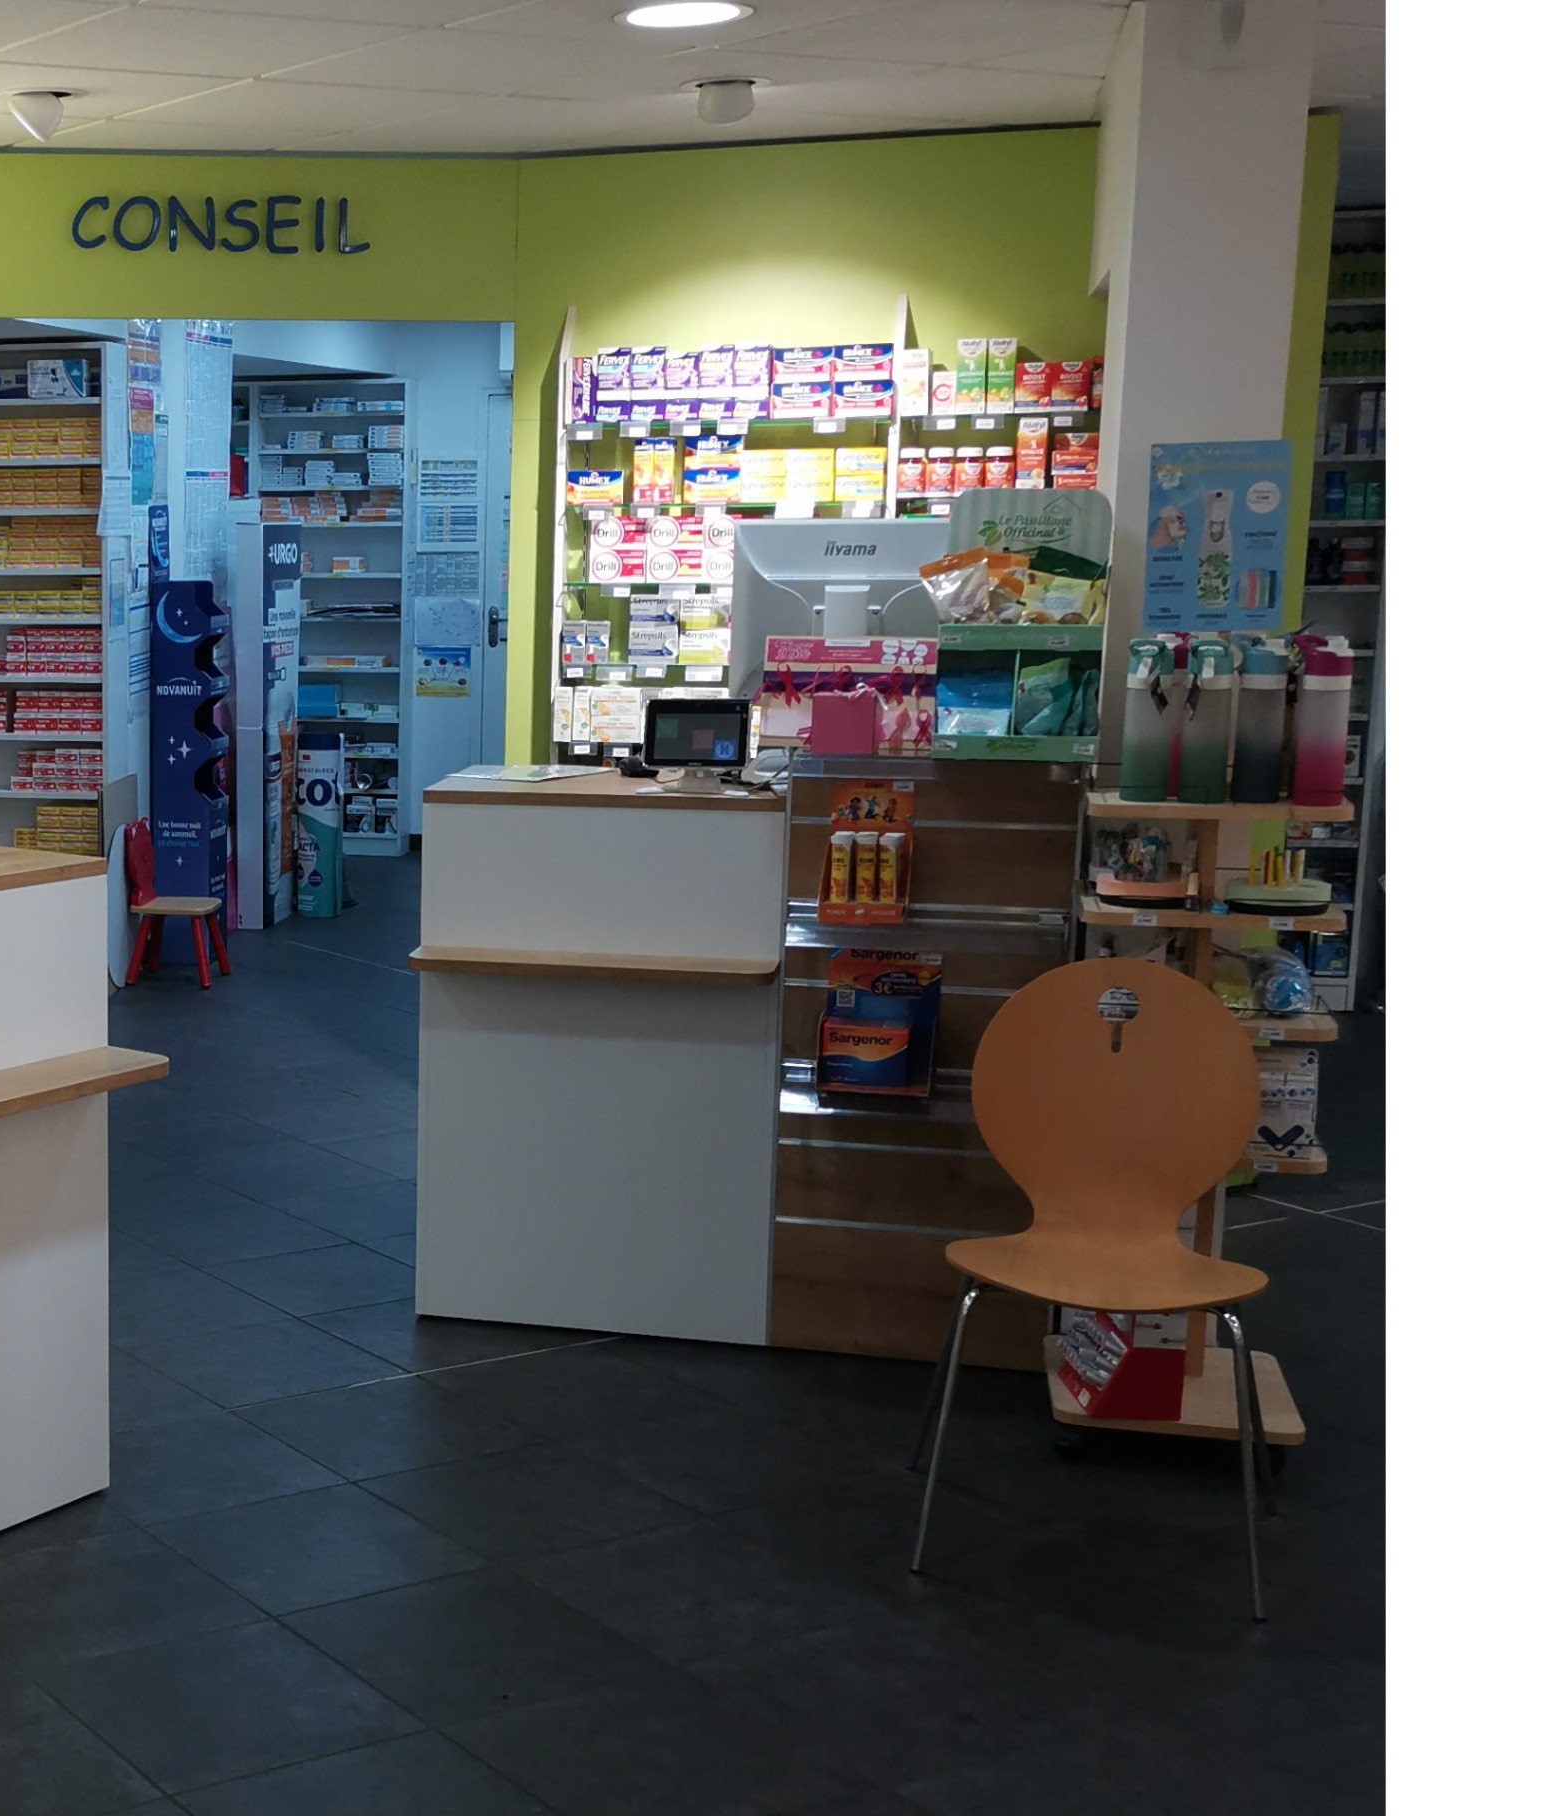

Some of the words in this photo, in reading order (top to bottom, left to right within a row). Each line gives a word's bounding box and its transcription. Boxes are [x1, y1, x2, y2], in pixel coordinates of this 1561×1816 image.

[71, 195, 370, 254] CONSEIL
[600, 354, 630, 366] FERVEX
[634, 354, 665, 365] FERVEX
[697, 440, 729, 450] HUMEX
[578, 475, 611, 485] HUMEX
[999, 514, 1012, 526] Le
[597, 528, 618, 538] Drill
[653, 528, 675, 538] Drill
[711, 528, 733, 537] Drill
[1003, 527, 1056, 538] Officinal
[823, 540, 878, 556] iiyama
[273, 543, 298, 564] URGO
[595, 561, 617, 571] Drill
[652, 561, 674, 571] Drill
[709, 561, 732, 570] Drill
[631, 631, 667, 640] Strepsils
[684, 631, 718, 640] Strepsils
[156, 683, 202, 696] NOVANUIT
[158, 820, 169, 828] Une
[170, 821, 189, 829] bonne
[189, 821, 201, 829] nuit
[850, 948, 919, 964] Sargenor
[829, 1031, 893, 1046] Sargenor
